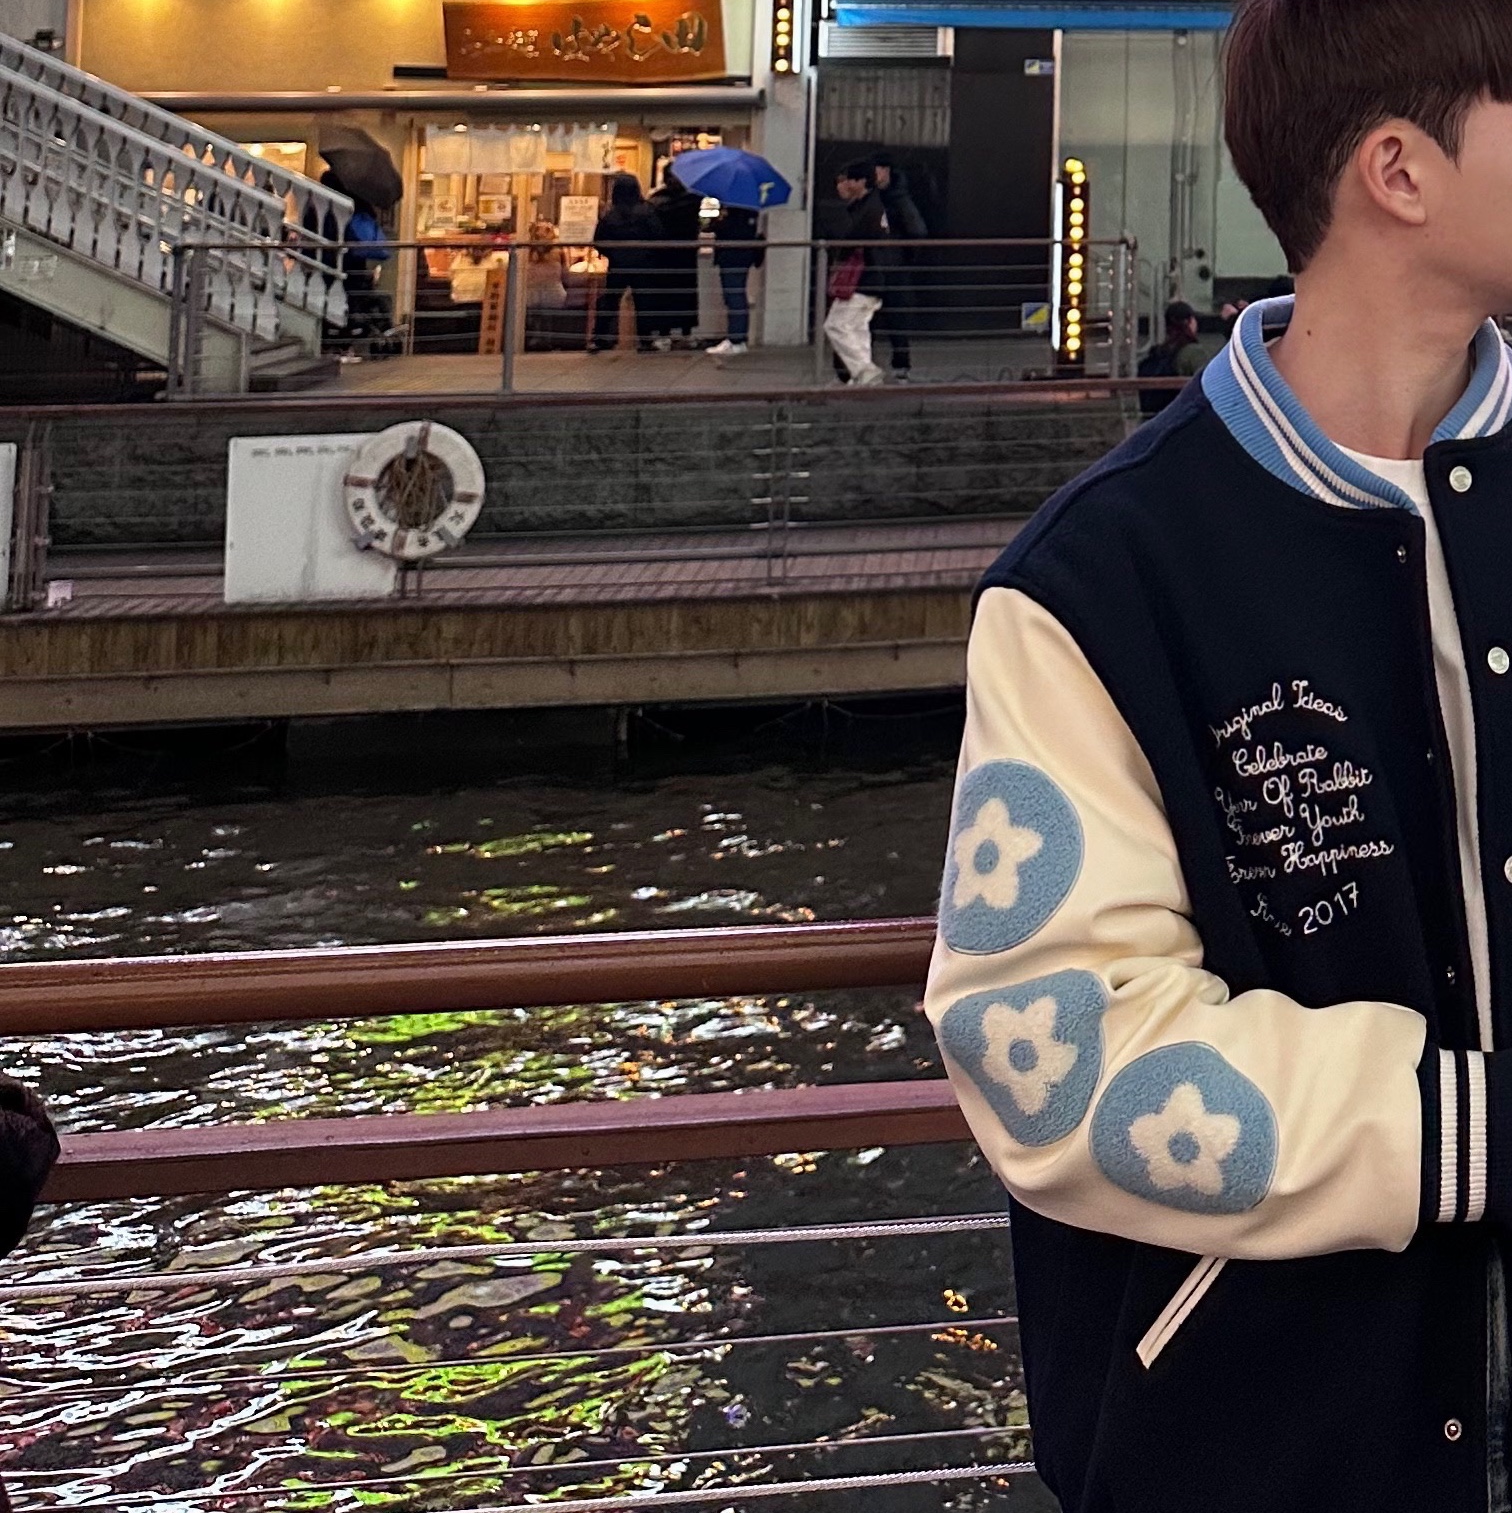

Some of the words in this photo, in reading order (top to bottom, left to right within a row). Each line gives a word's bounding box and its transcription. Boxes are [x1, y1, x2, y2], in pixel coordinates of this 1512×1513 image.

[1292, 680, 1348, 722] Ideas
[1232, 742, 1328, 777] Celebrate
[1263, 775, 1294, 818] Of
[1299, 761, 1373, 797] Rabbit
[1300, 795, 1365, 846] Youth
[1281, 840, 1394, 876] Happiness
[1298, 881, 1360, 935] 2017
